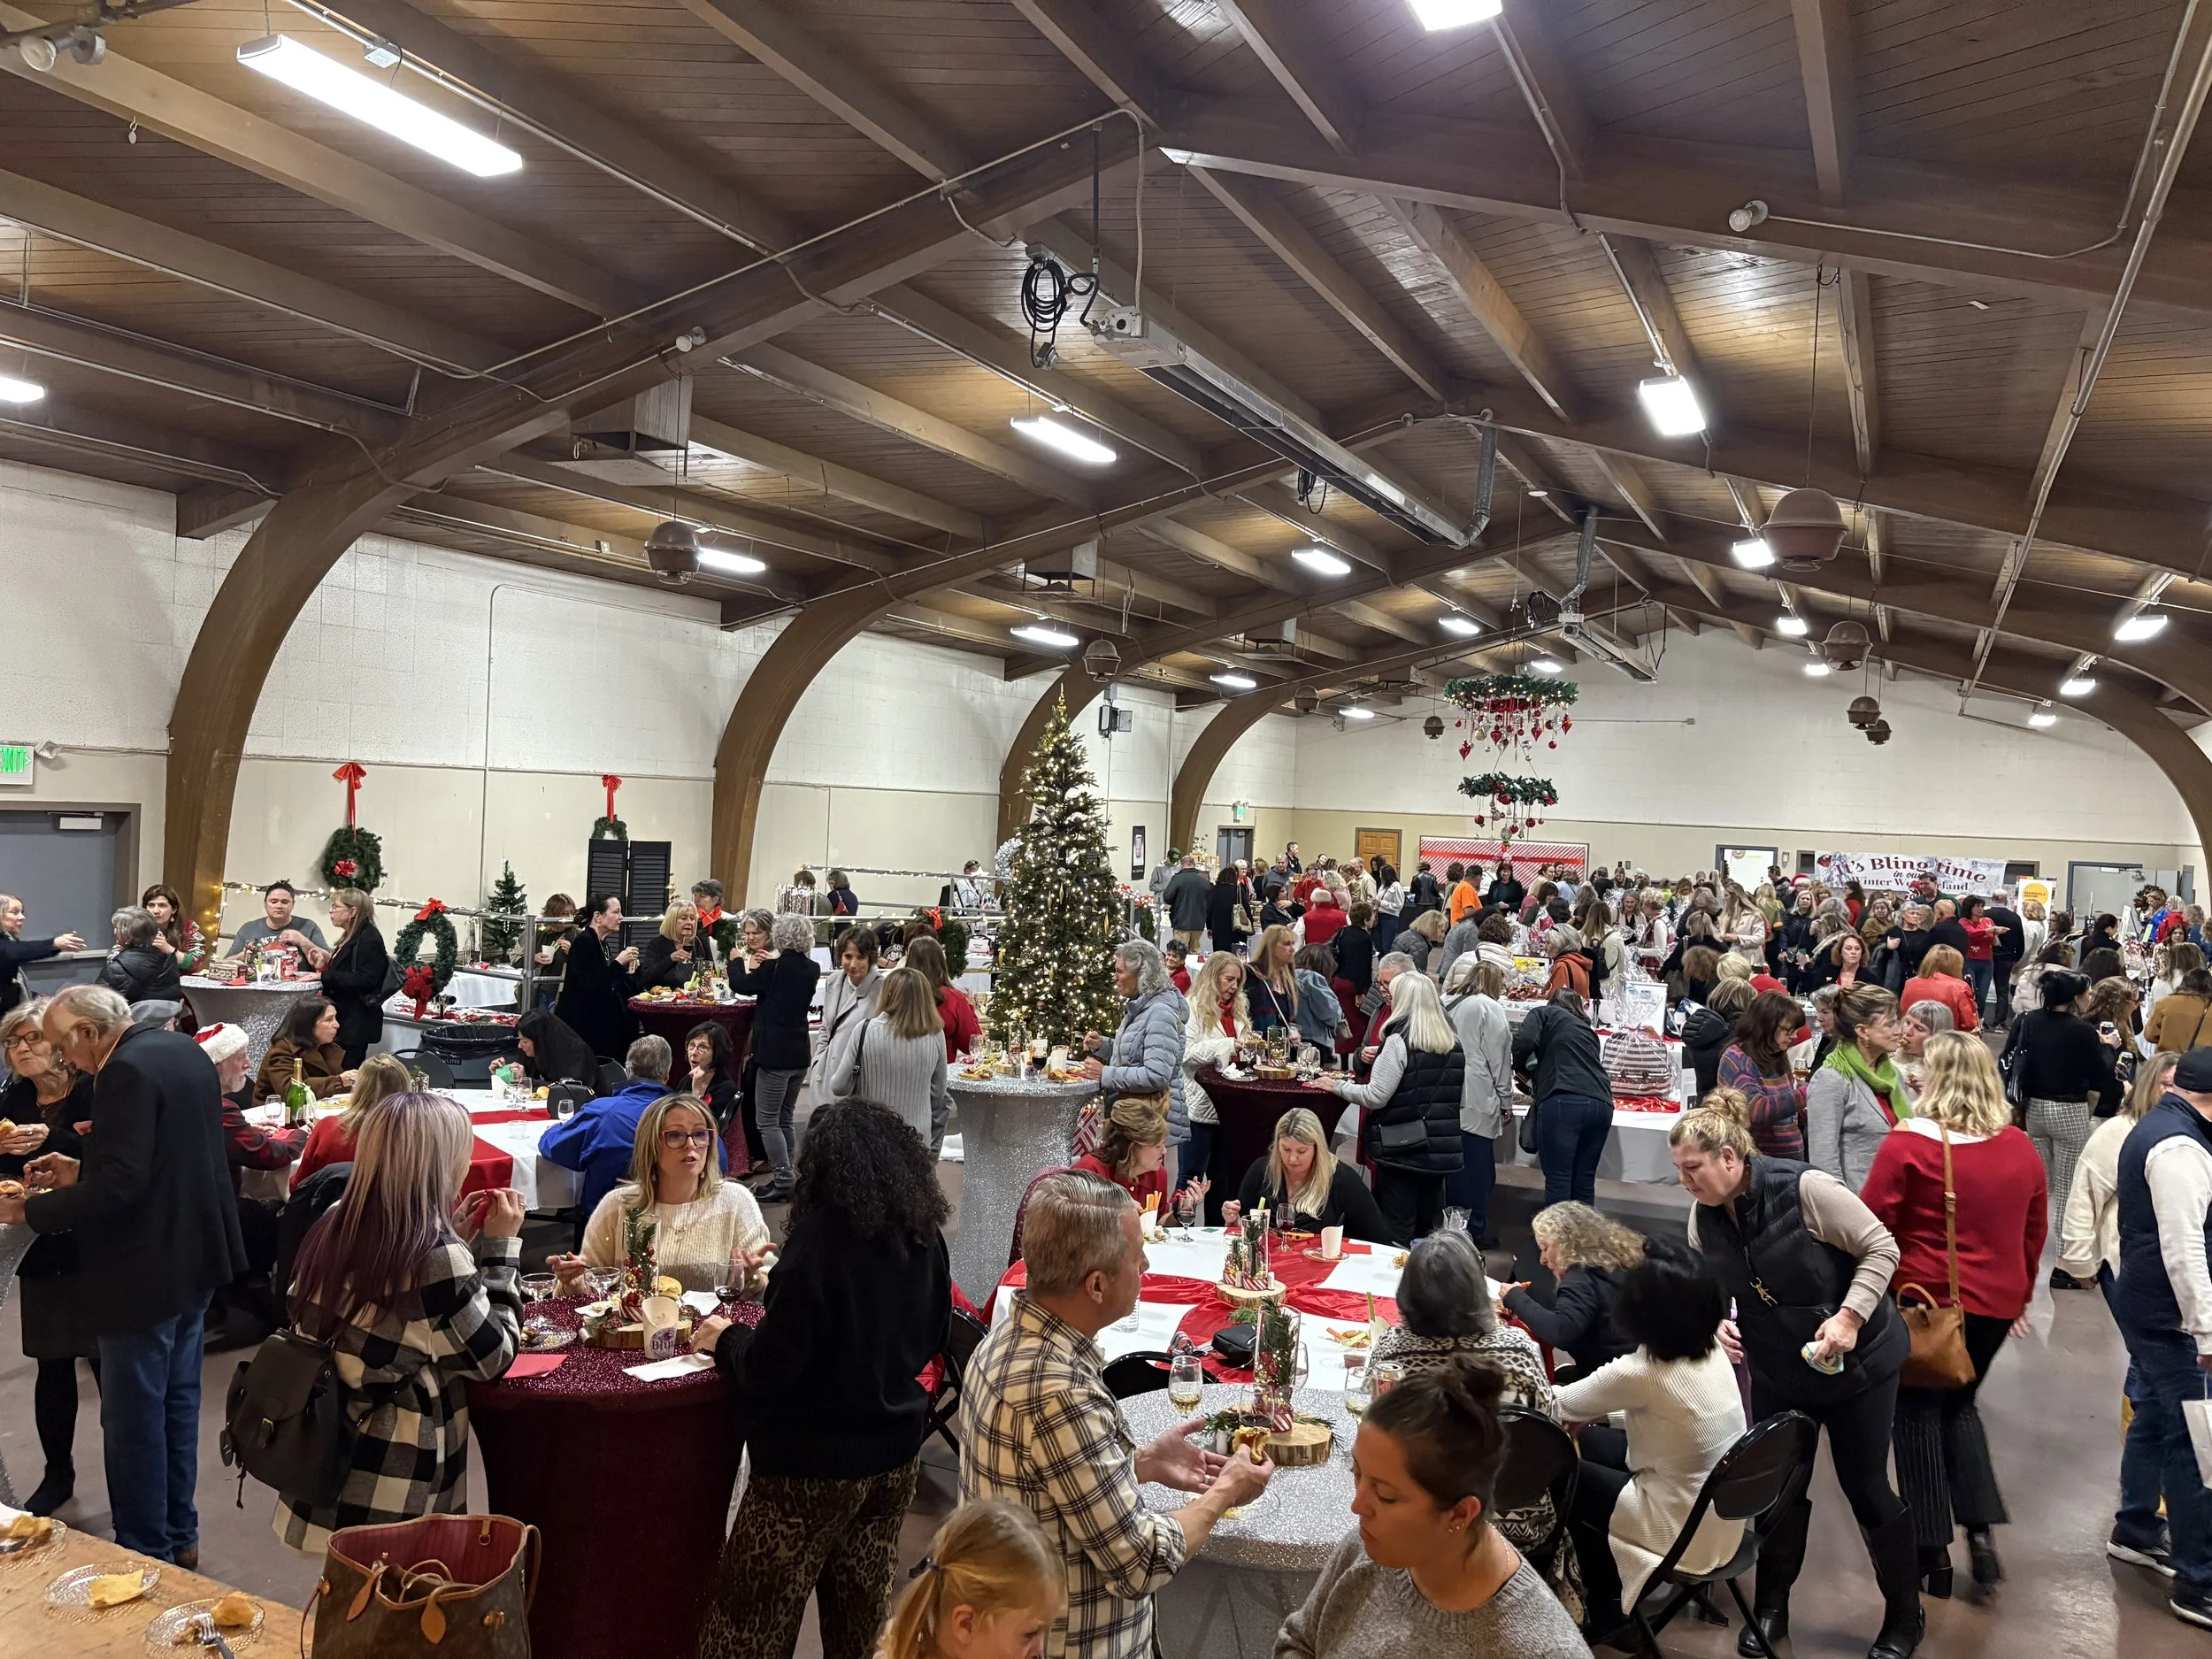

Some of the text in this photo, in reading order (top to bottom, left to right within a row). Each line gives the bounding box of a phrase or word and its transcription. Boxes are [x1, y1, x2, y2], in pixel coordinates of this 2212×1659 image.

[0, 747, 27, 773] XIT
[1836, 860, 1864, 875] It's
[1870, 856, 1929, 873] Bling
[1935, 861, 1986, 883] time
